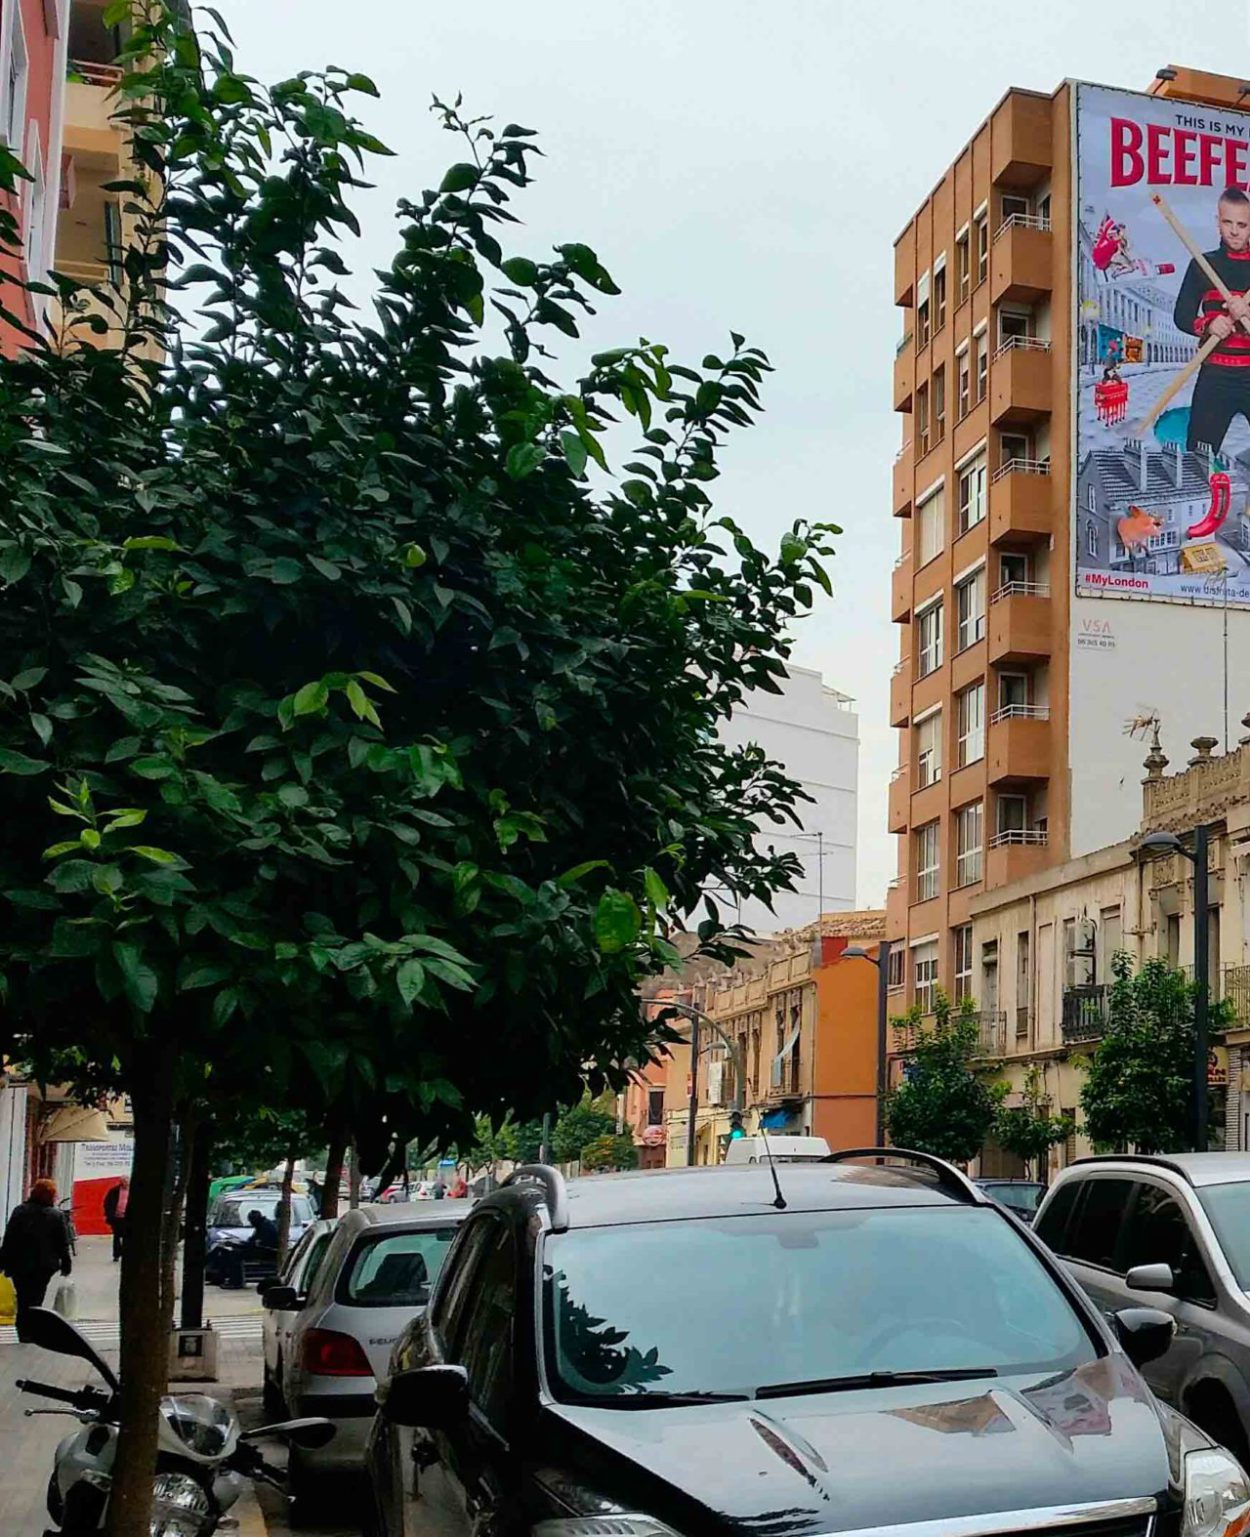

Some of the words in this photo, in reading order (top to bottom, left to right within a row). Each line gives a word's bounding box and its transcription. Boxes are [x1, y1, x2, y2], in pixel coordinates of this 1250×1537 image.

[1175, 114, 1205, 129] THIS
[1209, 121, 1222, 132] IS
[1225, 124, 1245, 136] MY
[1085, 573, 1149, 589] #MyLondon
